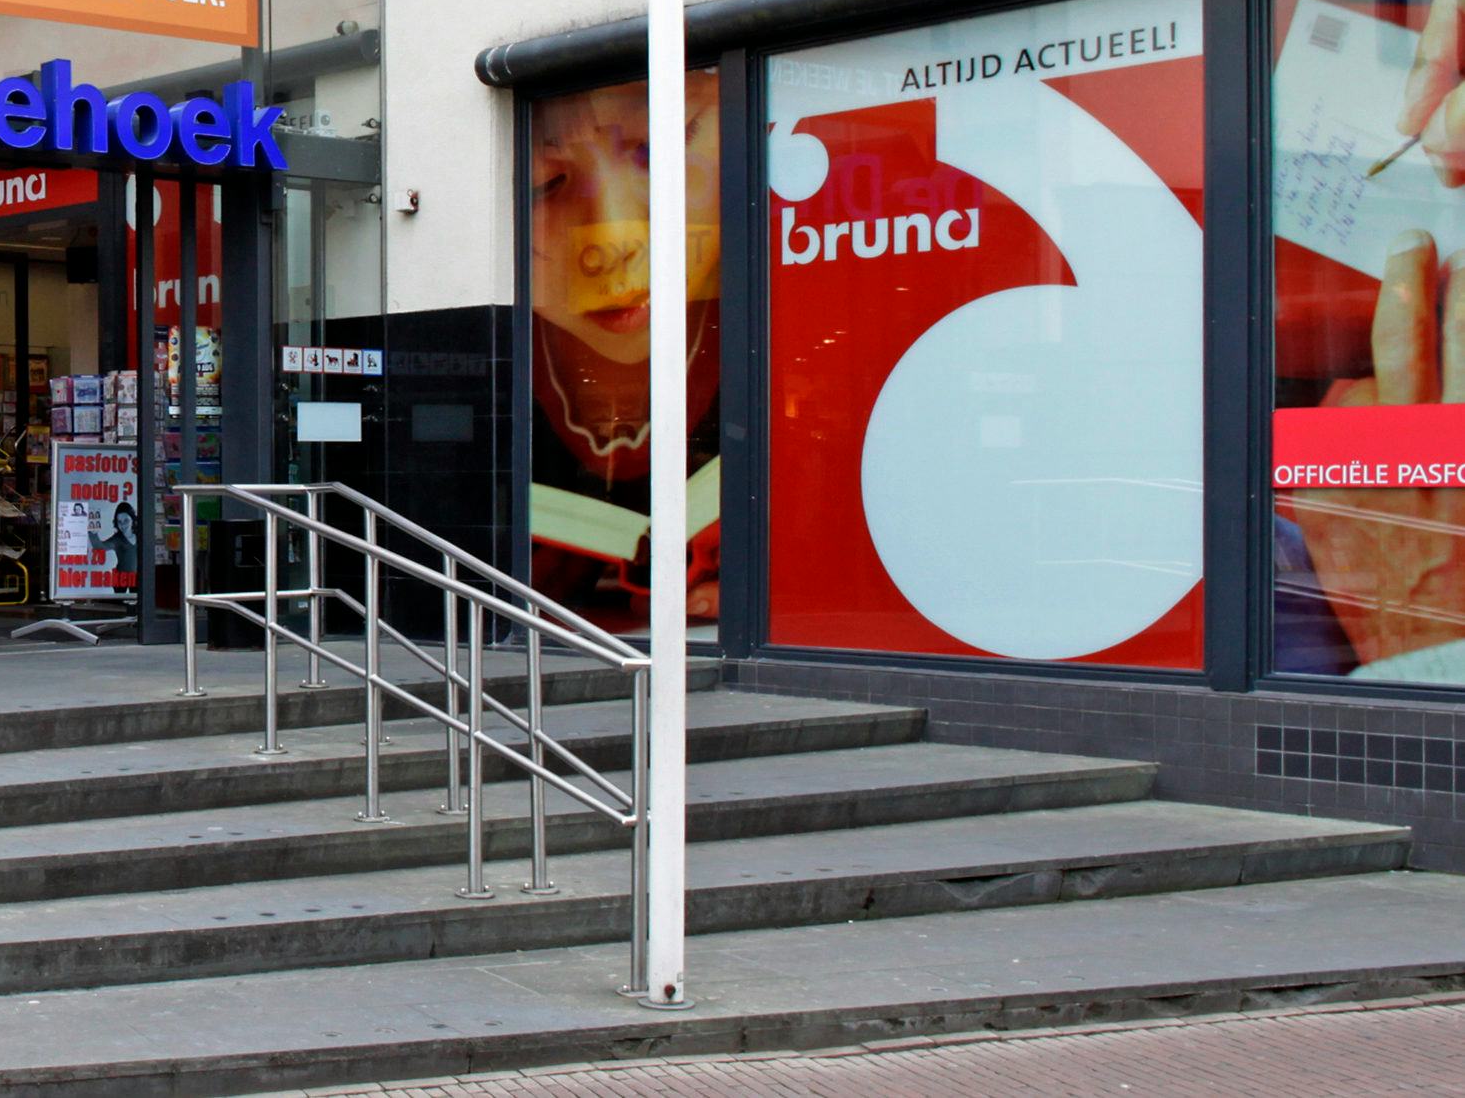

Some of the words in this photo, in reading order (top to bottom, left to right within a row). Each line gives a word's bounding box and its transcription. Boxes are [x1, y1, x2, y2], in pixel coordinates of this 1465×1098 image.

[900, 53, 1003, 93] ALTIJD
[1014, 21, 1178, 74] ACTUEEL!
[781, 206, 981, 265] bruna
[1274, 459, 1388, 484] OFFICIËLE
